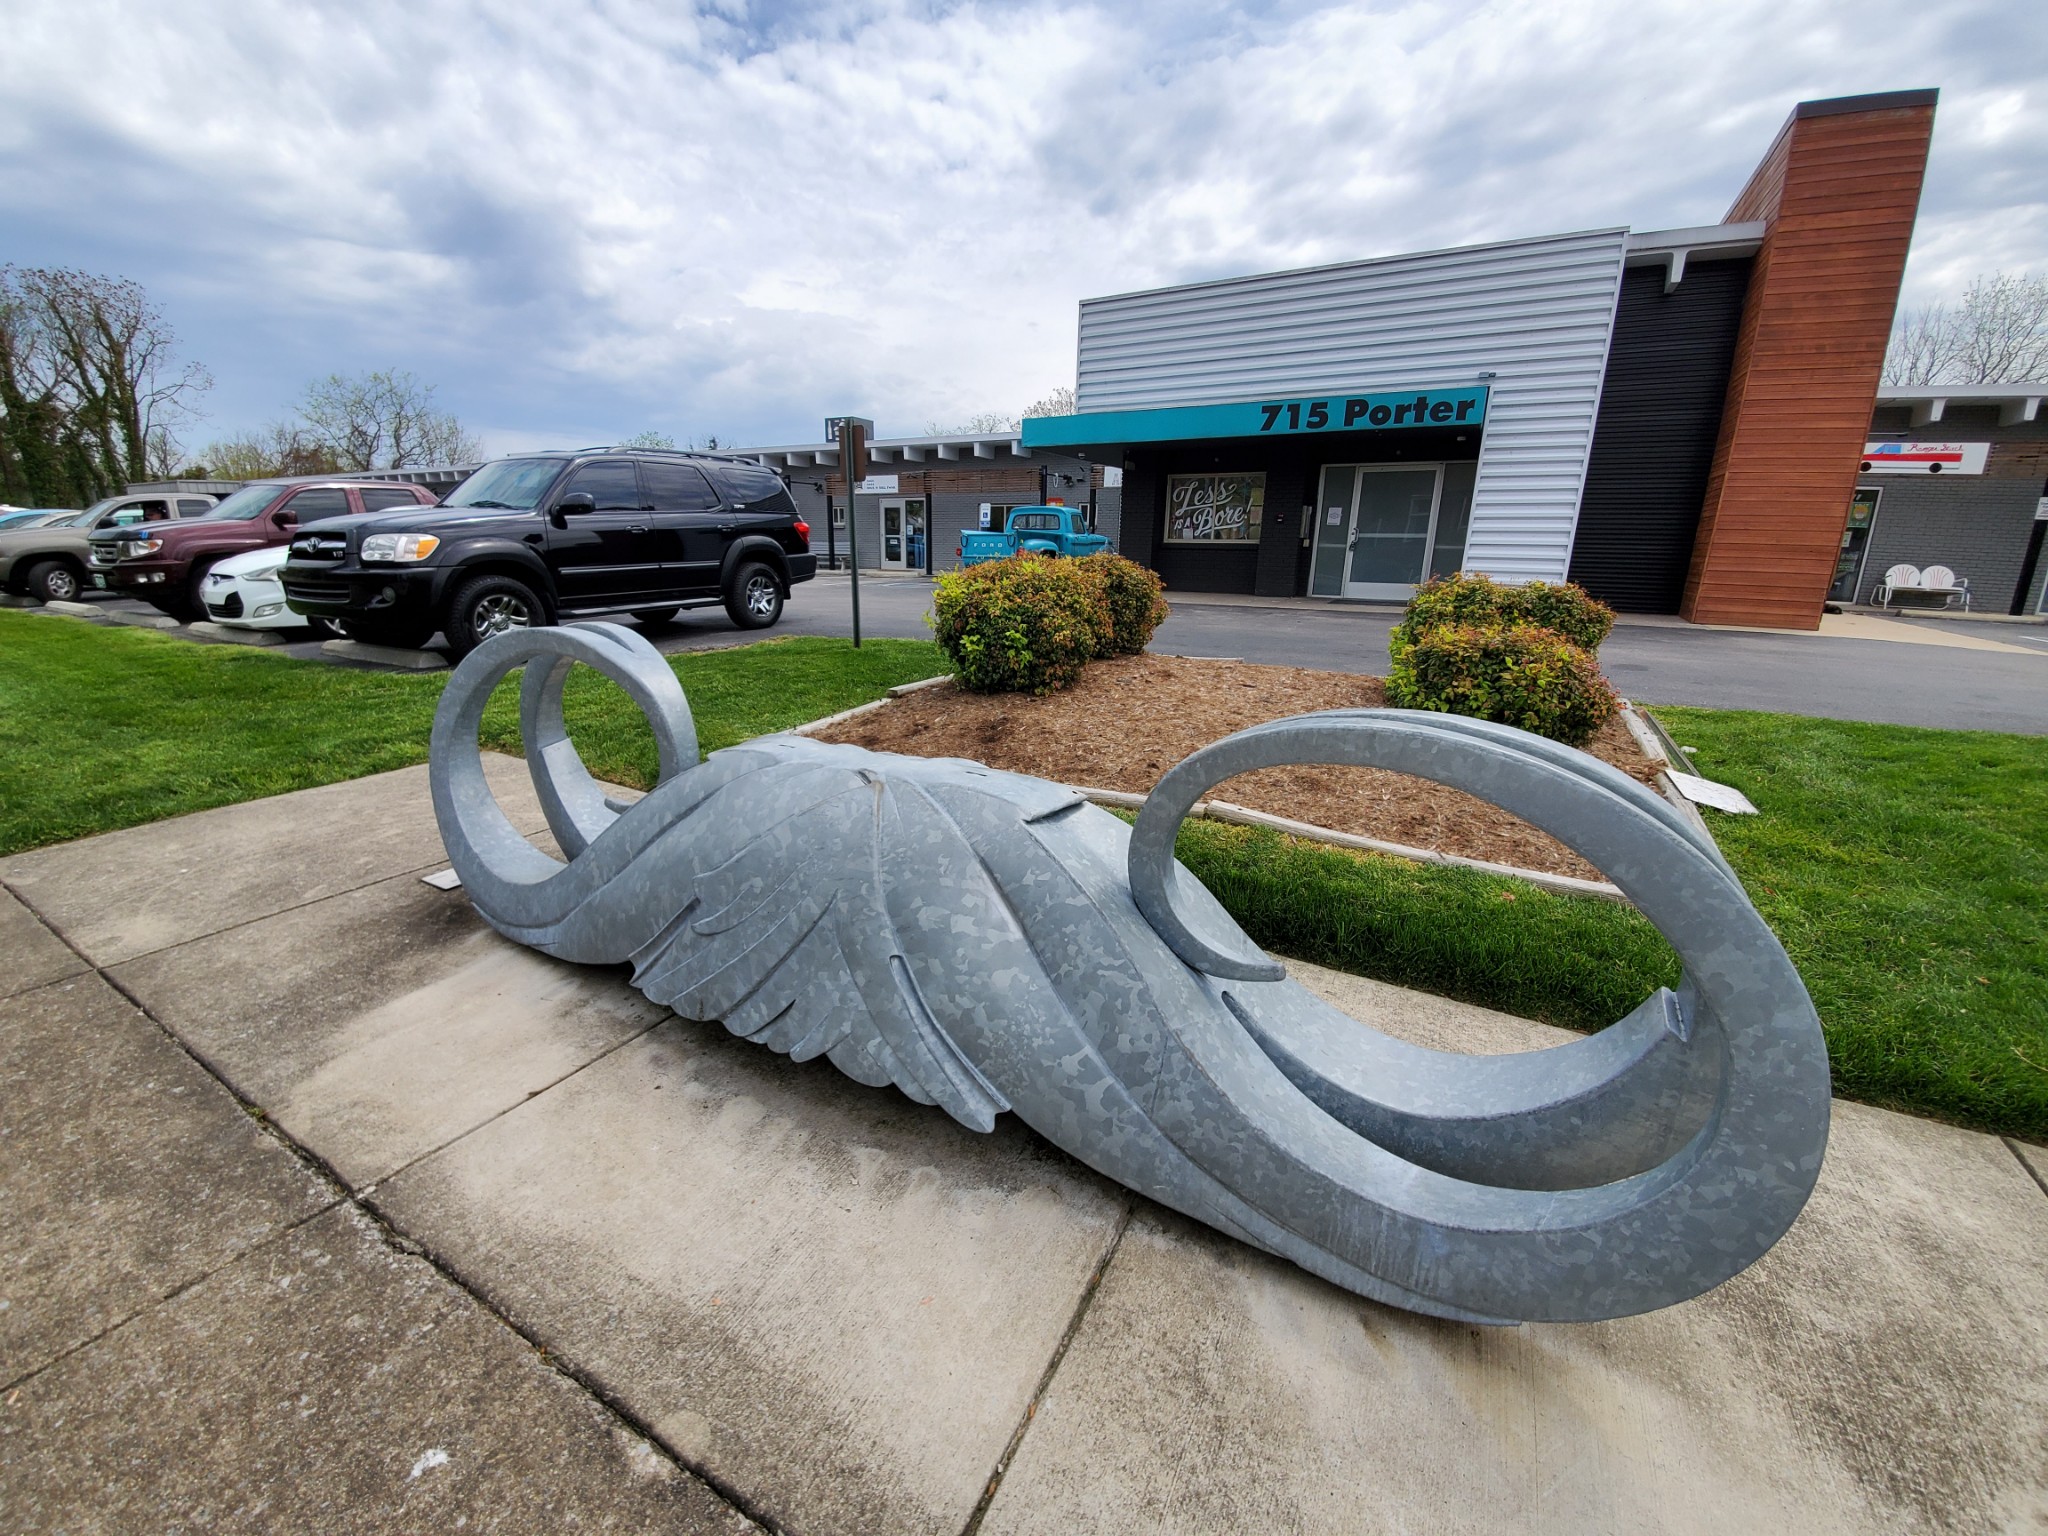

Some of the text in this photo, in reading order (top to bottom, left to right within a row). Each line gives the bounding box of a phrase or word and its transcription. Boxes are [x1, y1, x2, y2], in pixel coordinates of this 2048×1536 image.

[1260, 396, 1476, 431] 715 Porter
[1172, 481, 1237, 516] Less
[1193, 498, 1253, 536] Bore!
